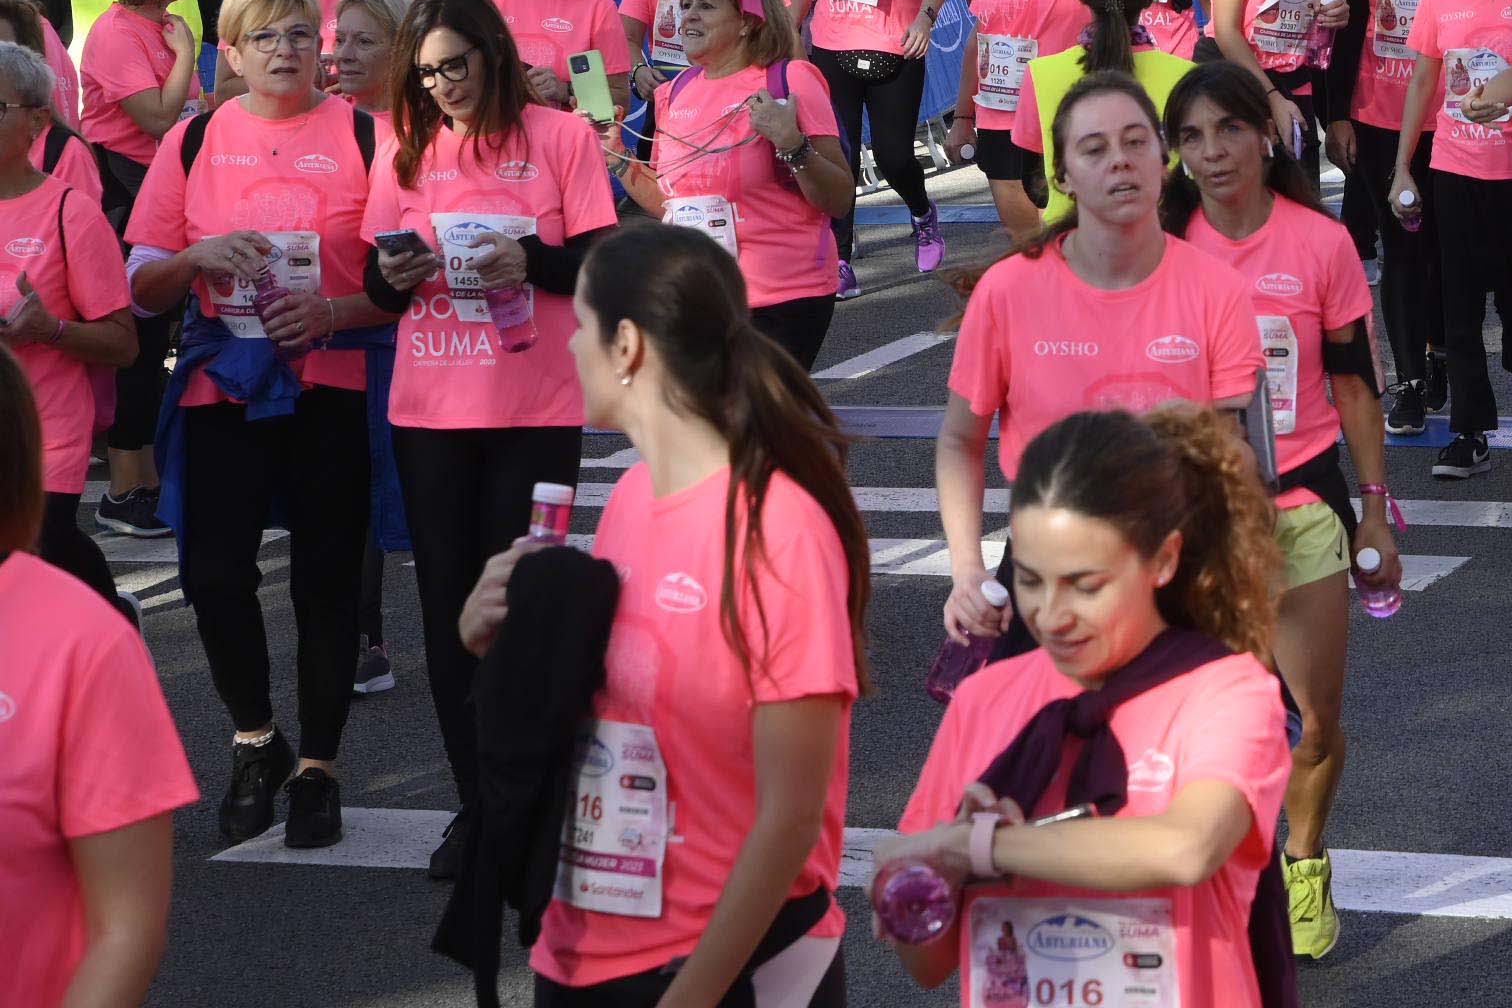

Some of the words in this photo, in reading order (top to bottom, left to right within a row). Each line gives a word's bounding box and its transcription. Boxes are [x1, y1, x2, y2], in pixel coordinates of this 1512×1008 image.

[1280, 9, 1301, 21] 016
[1400, 15, 1415, 26] 01
[1440, 10, 1475, 23] OYSHO
[990, 63, 1009, 76] 016
[1376, 57, 1413, 79] SUM
[211, 154, 259, 168] OYSHO
[296, 159, 337, 171] ASTURIANA
[454, 276, 479, 287] 1455
[1260, 279, 1300, 291] ASTURIANA
[410, 331, 494, 357] SUMA
[1034, 341, 1099, 357] OYSHO
[1148, 345, 1197, 357] ASTURIANA
[588, 881, 645, 899] Santander
[1035, 927, 1107, 949] ASTURIANA
[1036, 978, 1103, 1006] 016
